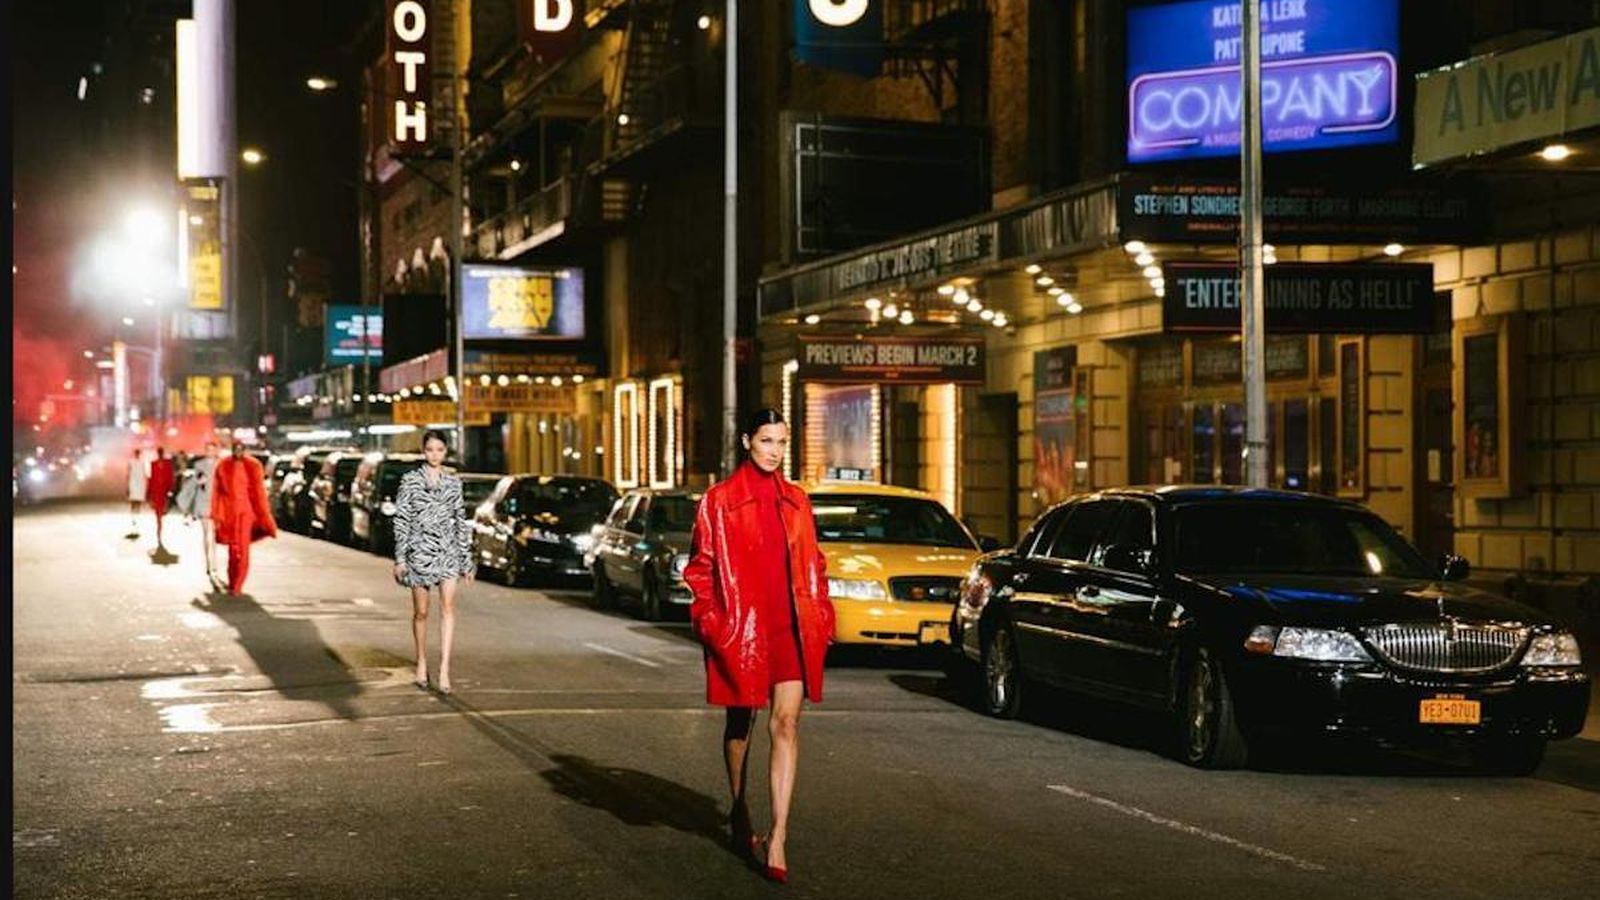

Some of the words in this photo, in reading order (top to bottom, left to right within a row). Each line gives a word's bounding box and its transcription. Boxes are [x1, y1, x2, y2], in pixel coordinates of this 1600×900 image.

[1140, 63, 1384, 132] COMPANY
[1477, 60, 1561, 127] New
[1134, 195, 1188, 215] STEPHEN
[1327, 279, 1354, 309] AS
[805, 344, 875, 365] PREVIEWS
[877, 344, 915, 365] BEGIN
[917, 345, 964, 366] MARCH
[966, 346, 978, 367] 2
